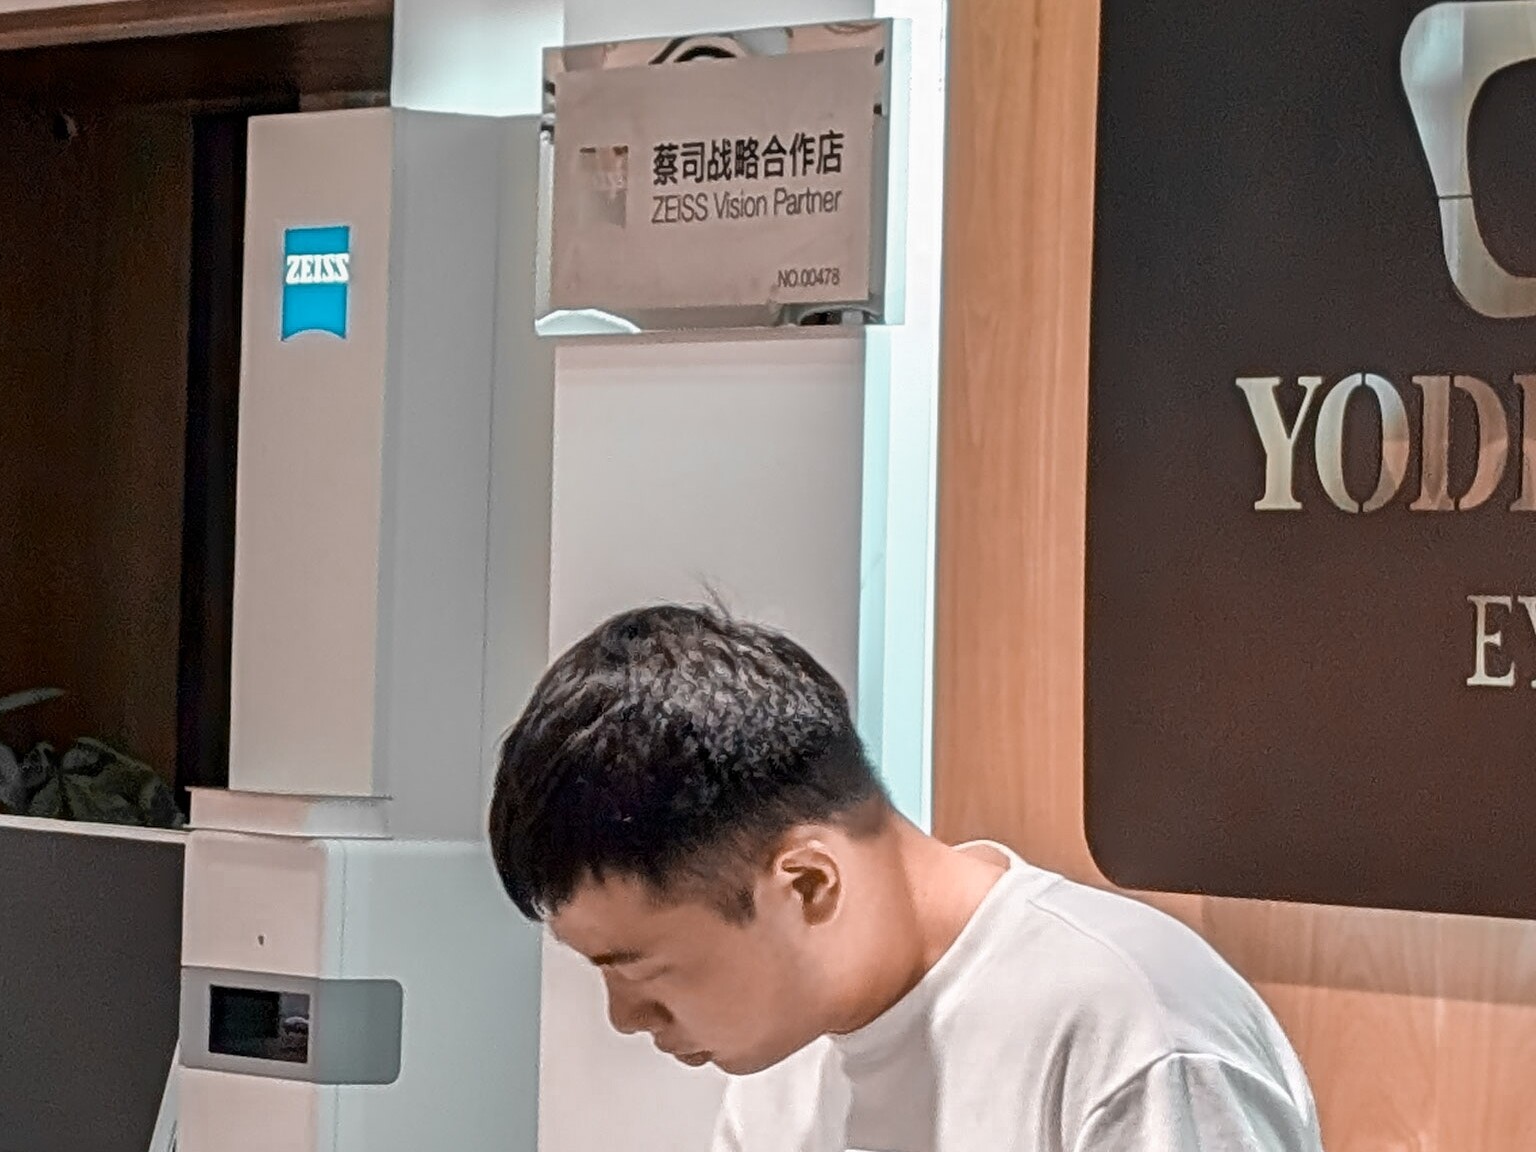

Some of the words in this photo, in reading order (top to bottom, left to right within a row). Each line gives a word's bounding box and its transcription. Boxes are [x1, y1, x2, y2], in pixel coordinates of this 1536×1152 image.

[653, 130, 845, 186] 蔡司战略合作店
[651, 192, 709, 224] ZEISS
[714, 188, 767, 219] Vision
[774, 186, 843, 217] Partner
[285, 253, 350, 285] ZEISS
